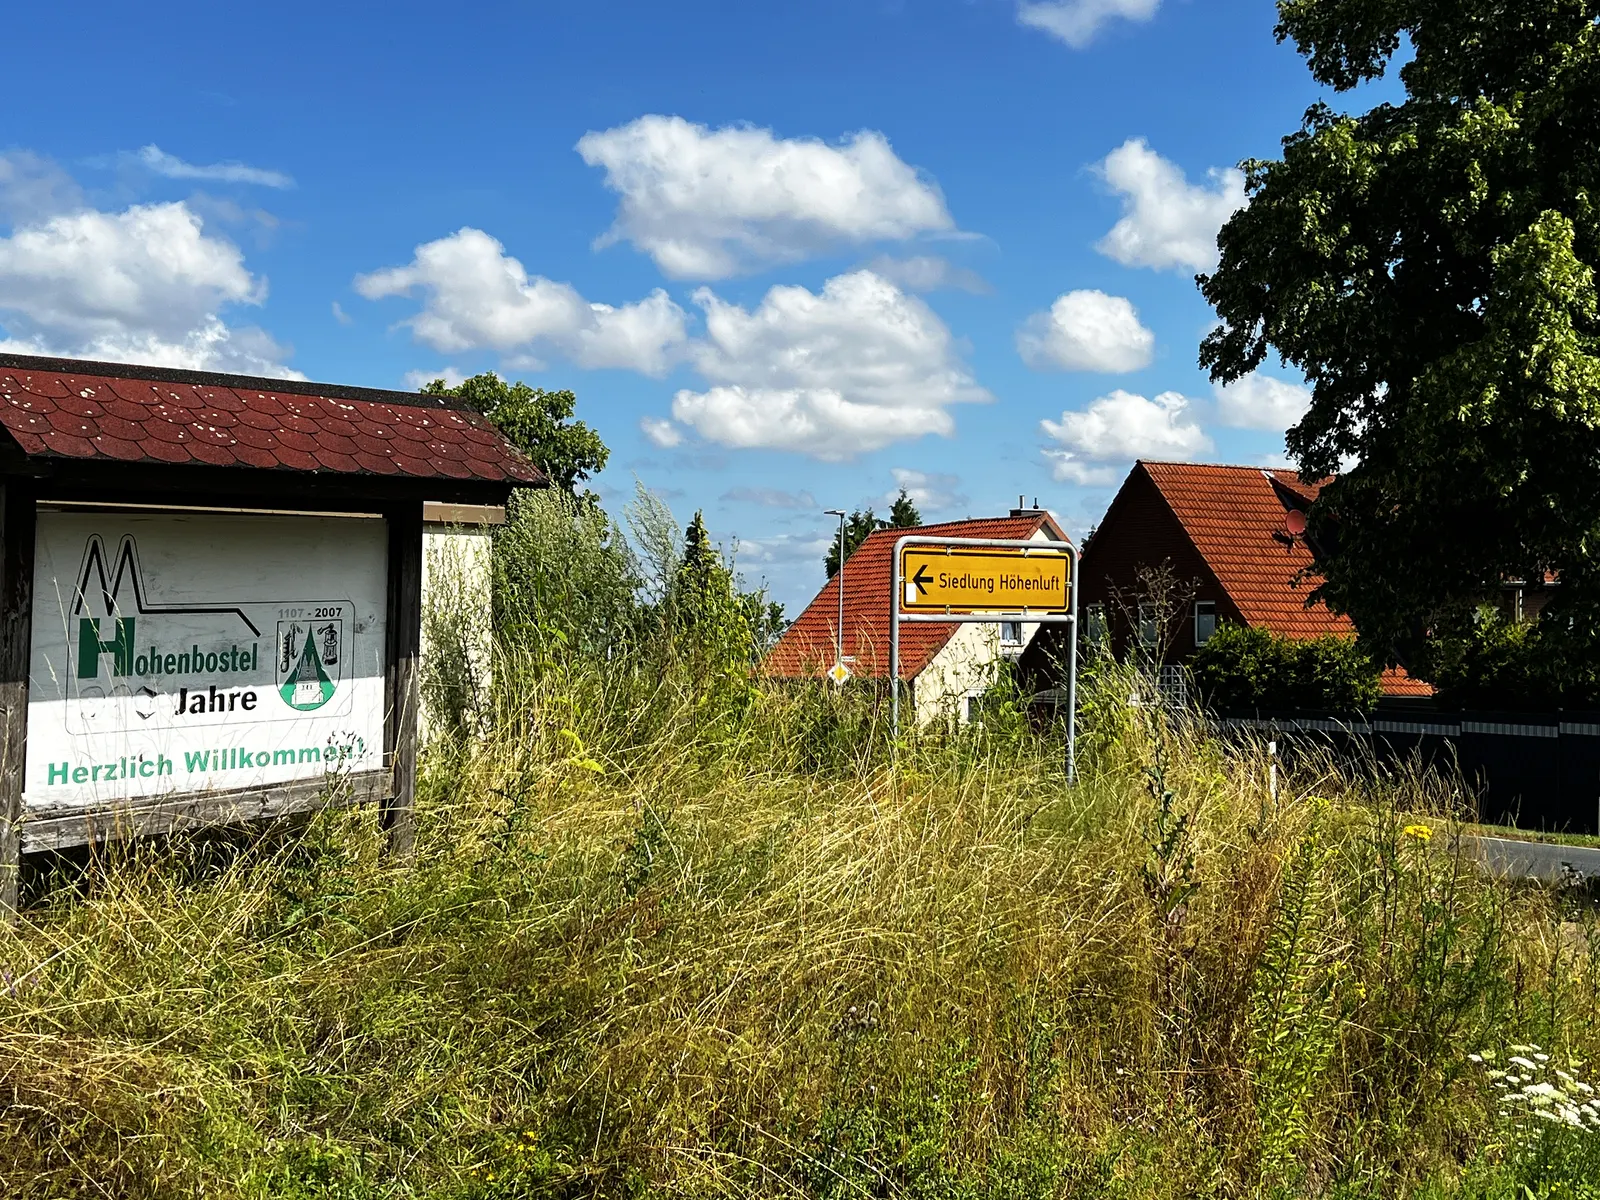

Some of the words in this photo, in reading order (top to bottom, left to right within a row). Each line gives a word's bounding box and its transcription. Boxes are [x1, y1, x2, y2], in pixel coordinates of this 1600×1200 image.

[939, 573, 994, 593] Siedlung
[999, 574, 1060, 591] Höhenluft
[278, 608, 304, 619] 1107
[314, 607, 342, 618] 2007
[77, 617, 257, 678] Hohenbostel
[174, 685, 258, 716] Jahre
[47, 753, 173, 786] Herzlich
